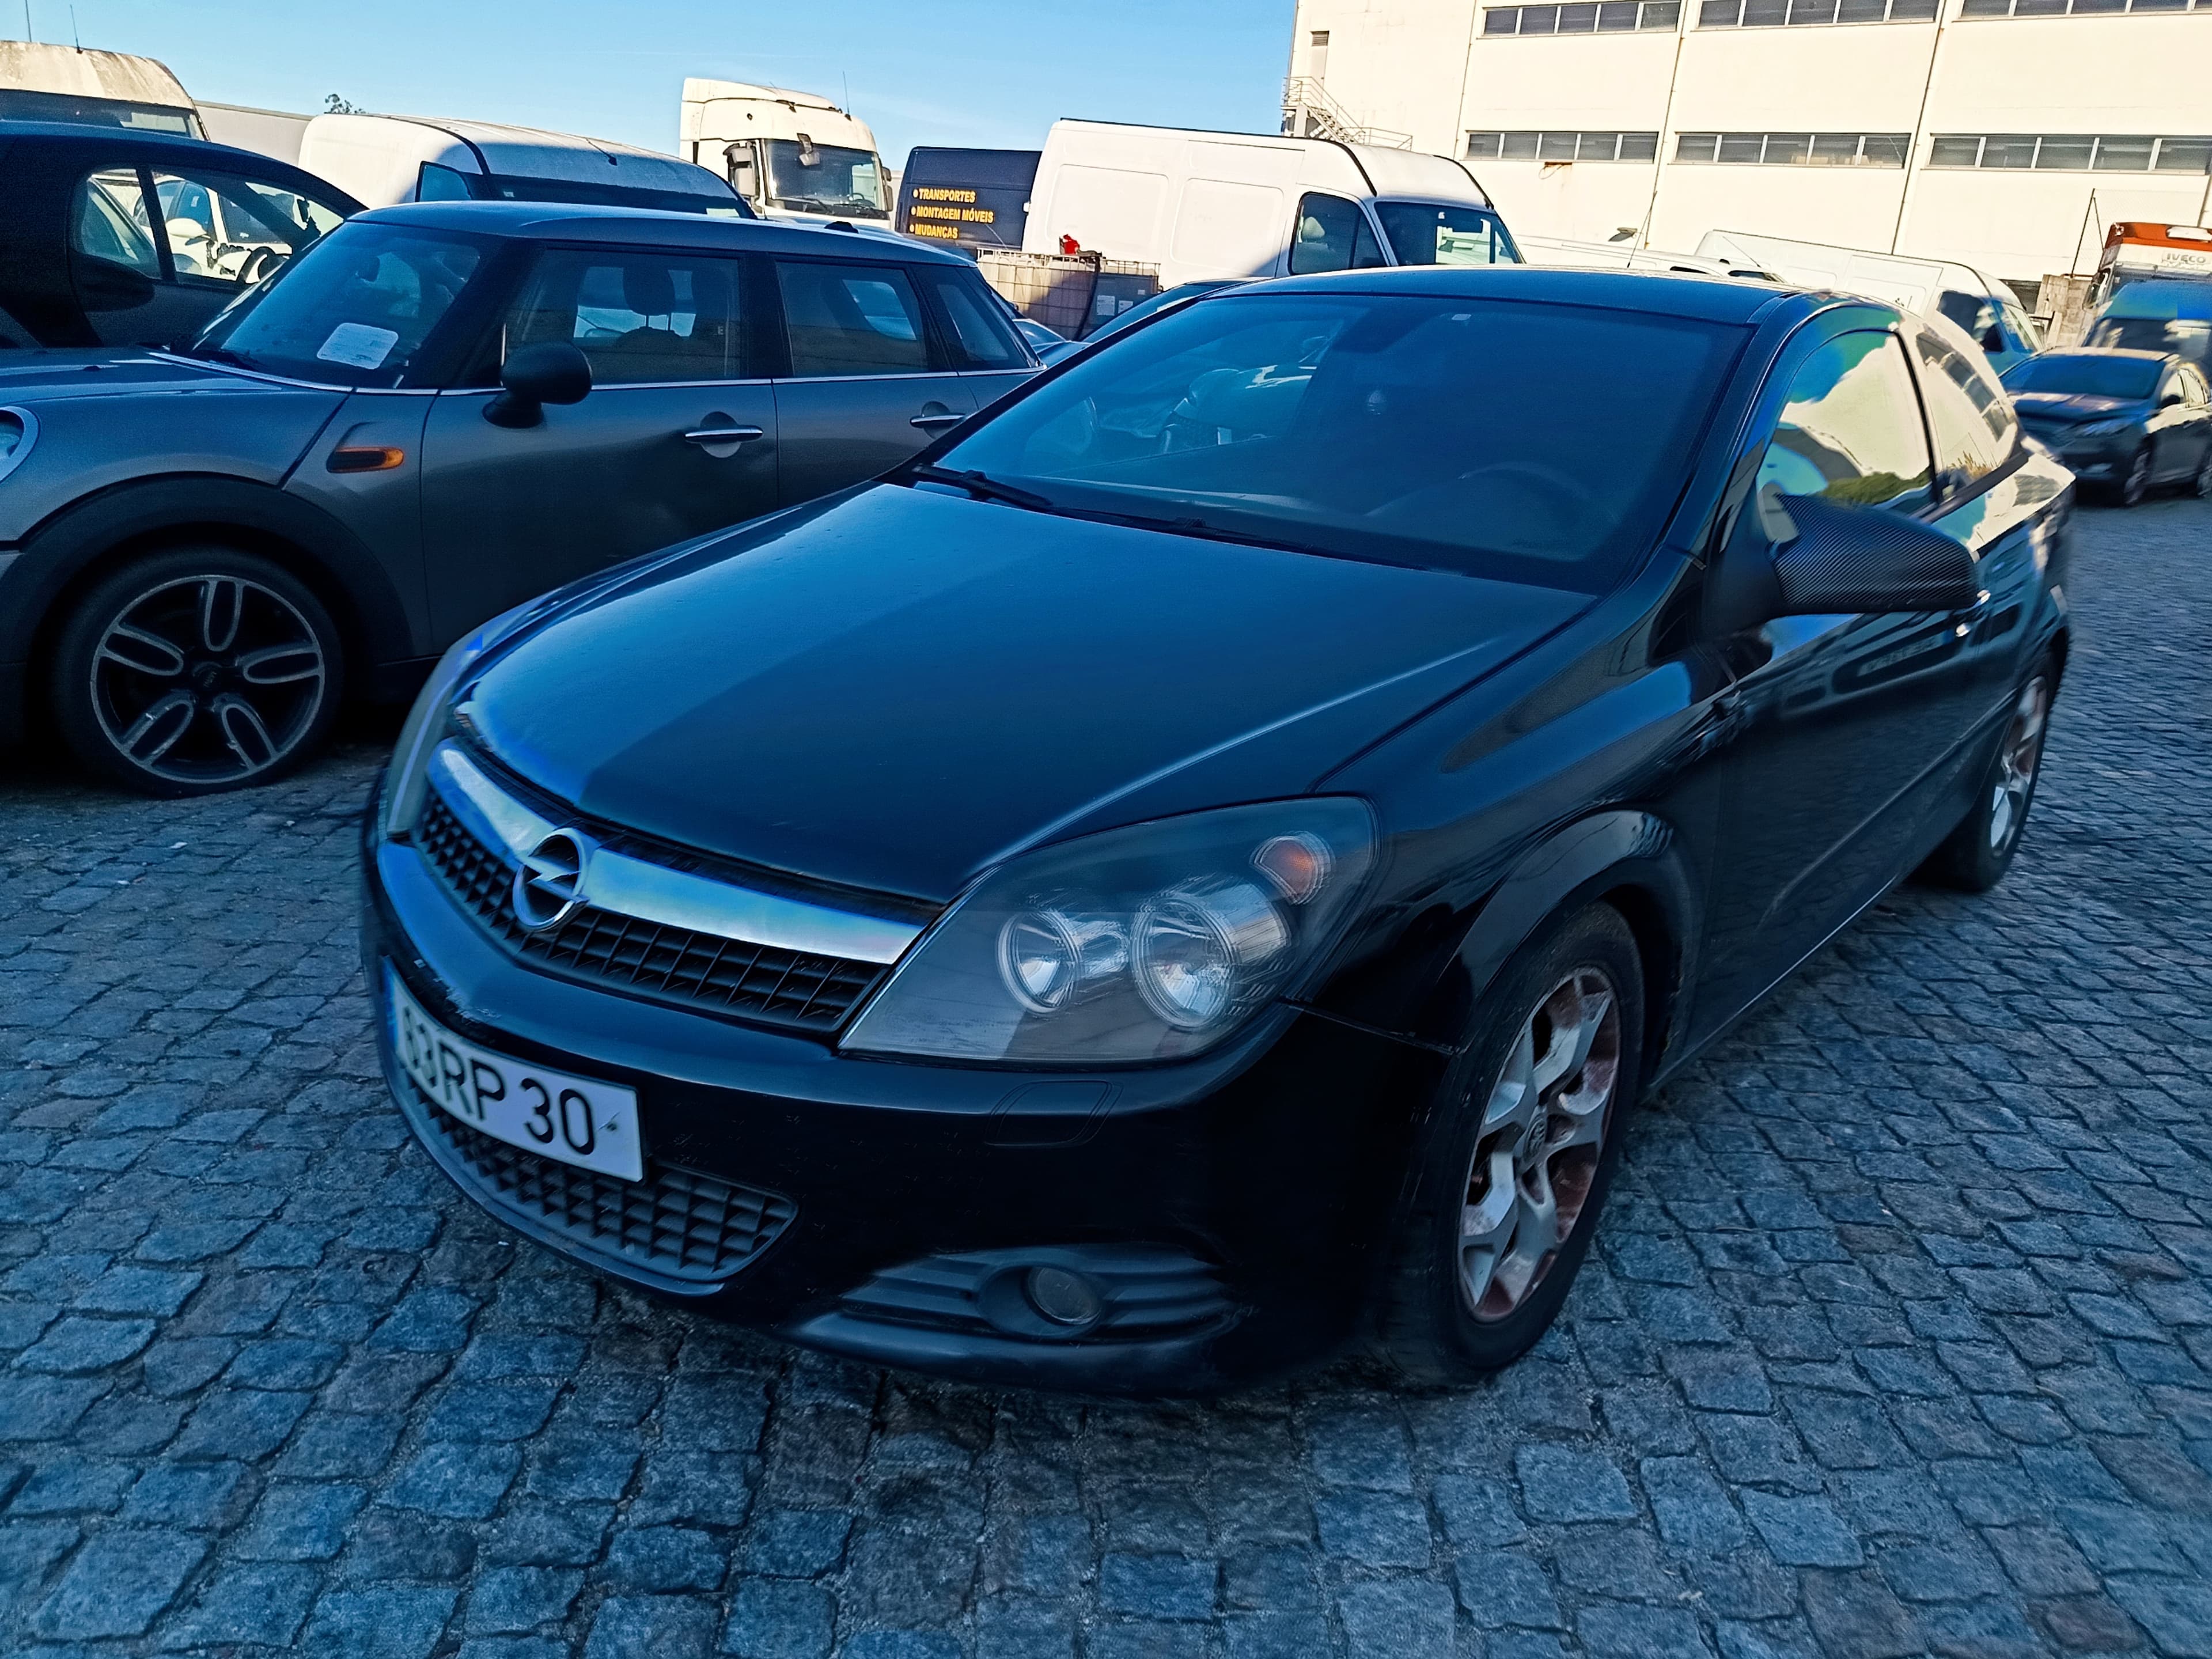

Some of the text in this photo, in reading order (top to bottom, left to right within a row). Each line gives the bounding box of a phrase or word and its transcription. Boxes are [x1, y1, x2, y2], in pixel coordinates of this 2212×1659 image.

[919, 188, 976, 203] TRANSPORTES
[916, 206, 994, 223] MONTAGEM MÓVEIS
[914, 224, 958, 238] MUDANÇAS
[2167, 253, 2206, 263] IVECO
[438, 1040, 505, 1120] RP
[518, 1077, 594, 1156] 30
